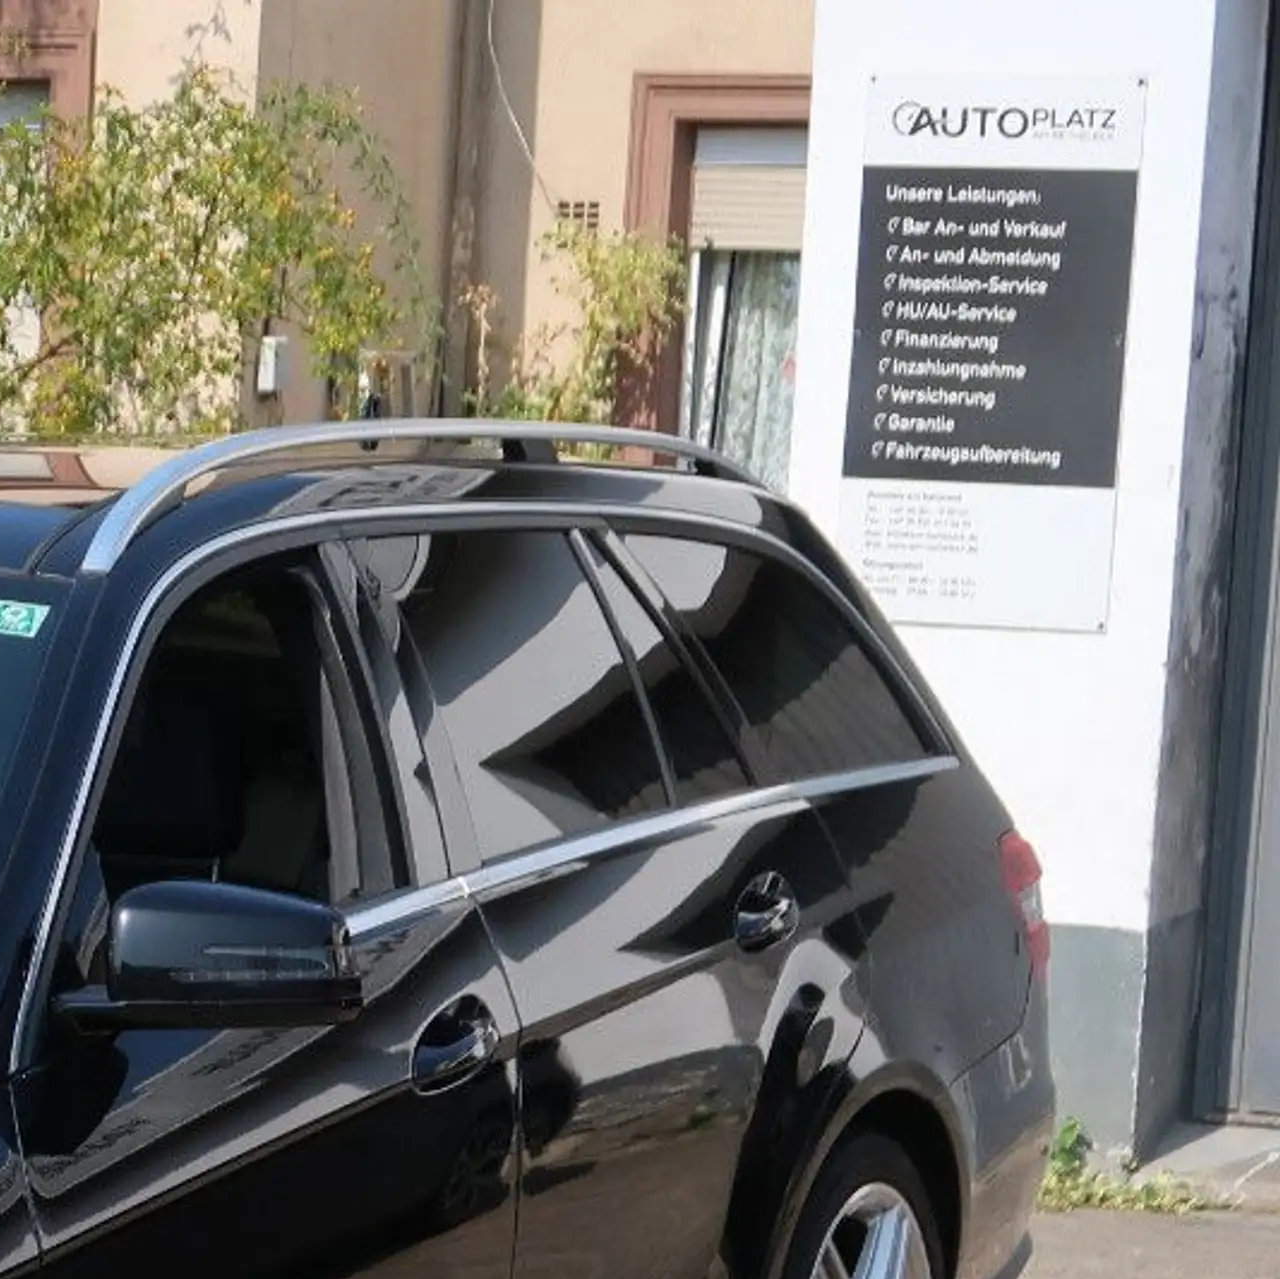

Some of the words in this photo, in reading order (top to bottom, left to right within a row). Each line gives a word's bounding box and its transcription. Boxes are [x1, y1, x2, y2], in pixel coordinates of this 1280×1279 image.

[886, 184, 943, 203] Unsere
[902, 217, 930, 236] Bar
[968, 220, 1000, 237] und
[1003, 219, 1067, 239] Verkauf
[934, 247, 965, 265] und
[968, 248, 1061, 270] Abmeldung
[898, 274, 1049, 295] Inspektion-Service
[896, 302, 1017, 322] HU/AU-Service
[895, 329, 999, 353] Finanzierung
[893, 358, 1027, 381] Inzahlungnahme
[890, 384, 996, 410] Versicherung
[888, 413, 955, 433] Garantie
[885, 441, 1062, 469] Fahrzeugaufbereitung
